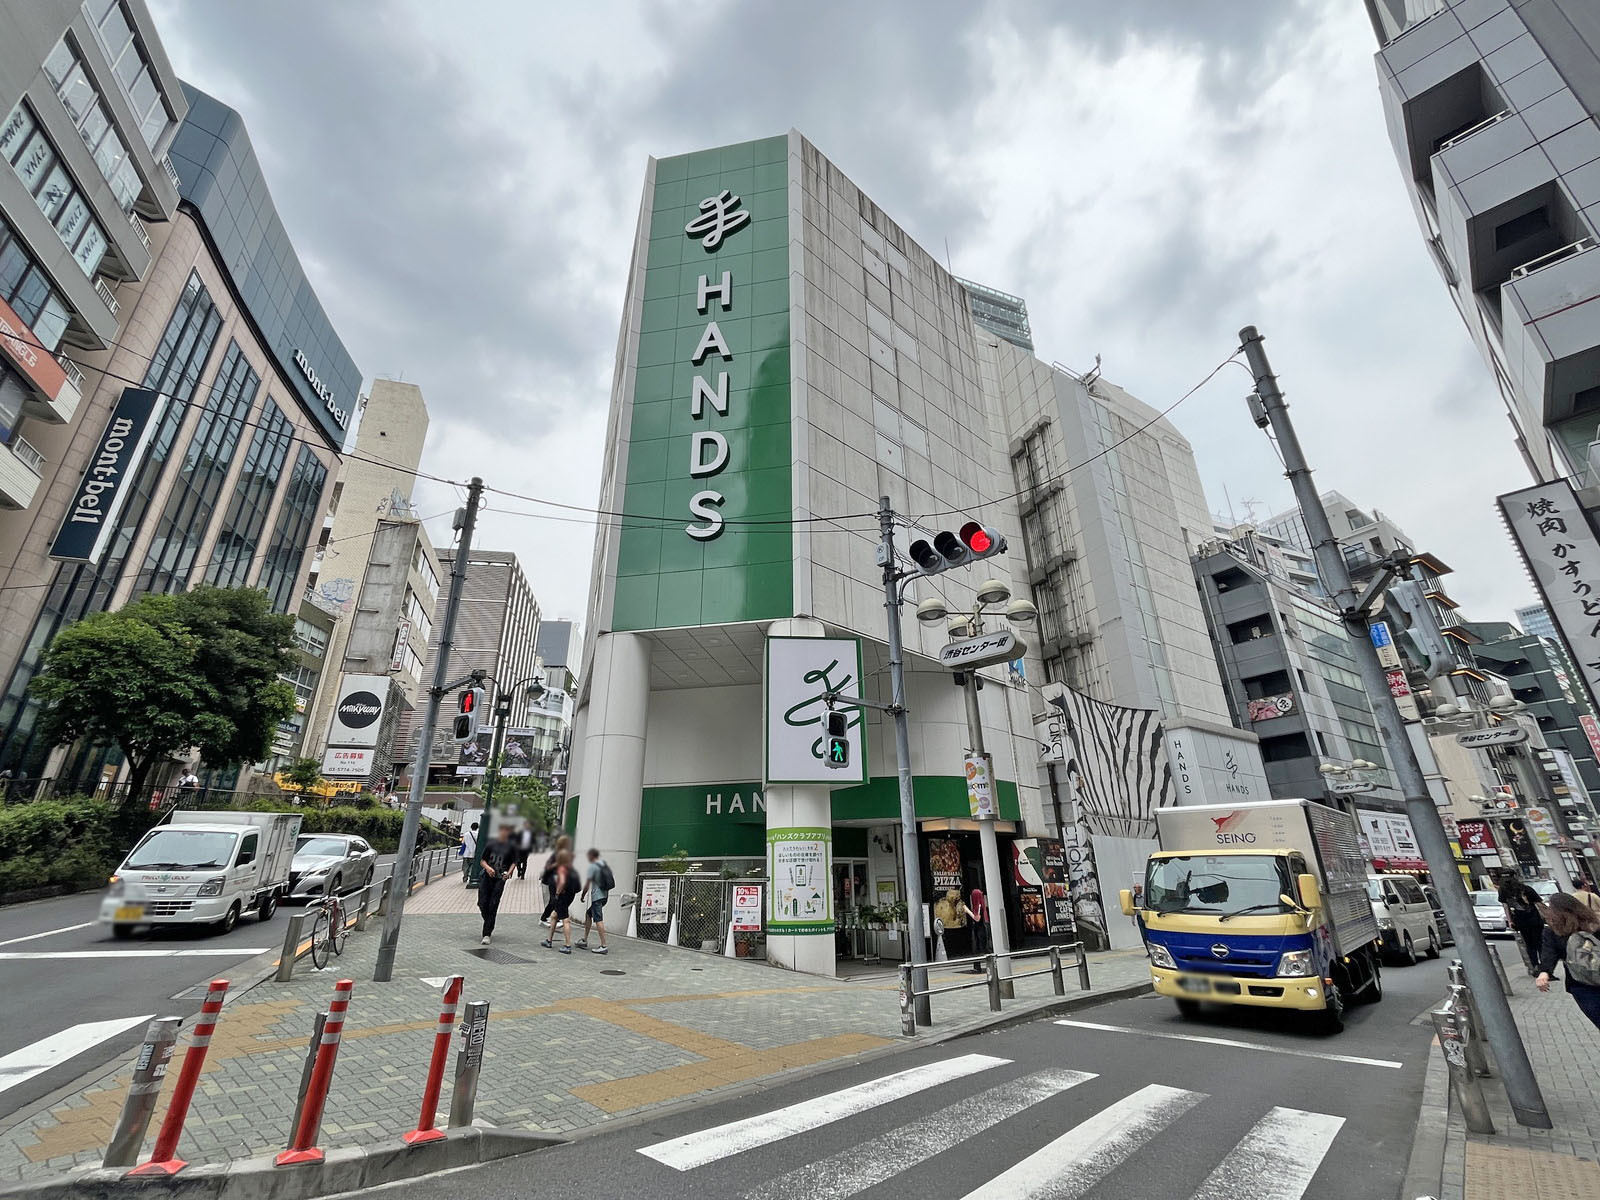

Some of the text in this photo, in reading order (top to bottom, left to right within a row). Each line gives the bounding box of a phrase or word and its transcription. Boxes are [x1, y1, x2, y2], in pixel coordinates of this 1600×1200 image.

[685, 270, 733, 542] HANDS
[943, 636, 1008, 660] 渋谷センター街
[1174, 740, 1192, 794] HANDS
[1226, 783, 1250, 795] HANDS
[1217, 832, 1256, 844] SEINO
[934, 877, 962, 886] PIZZA
